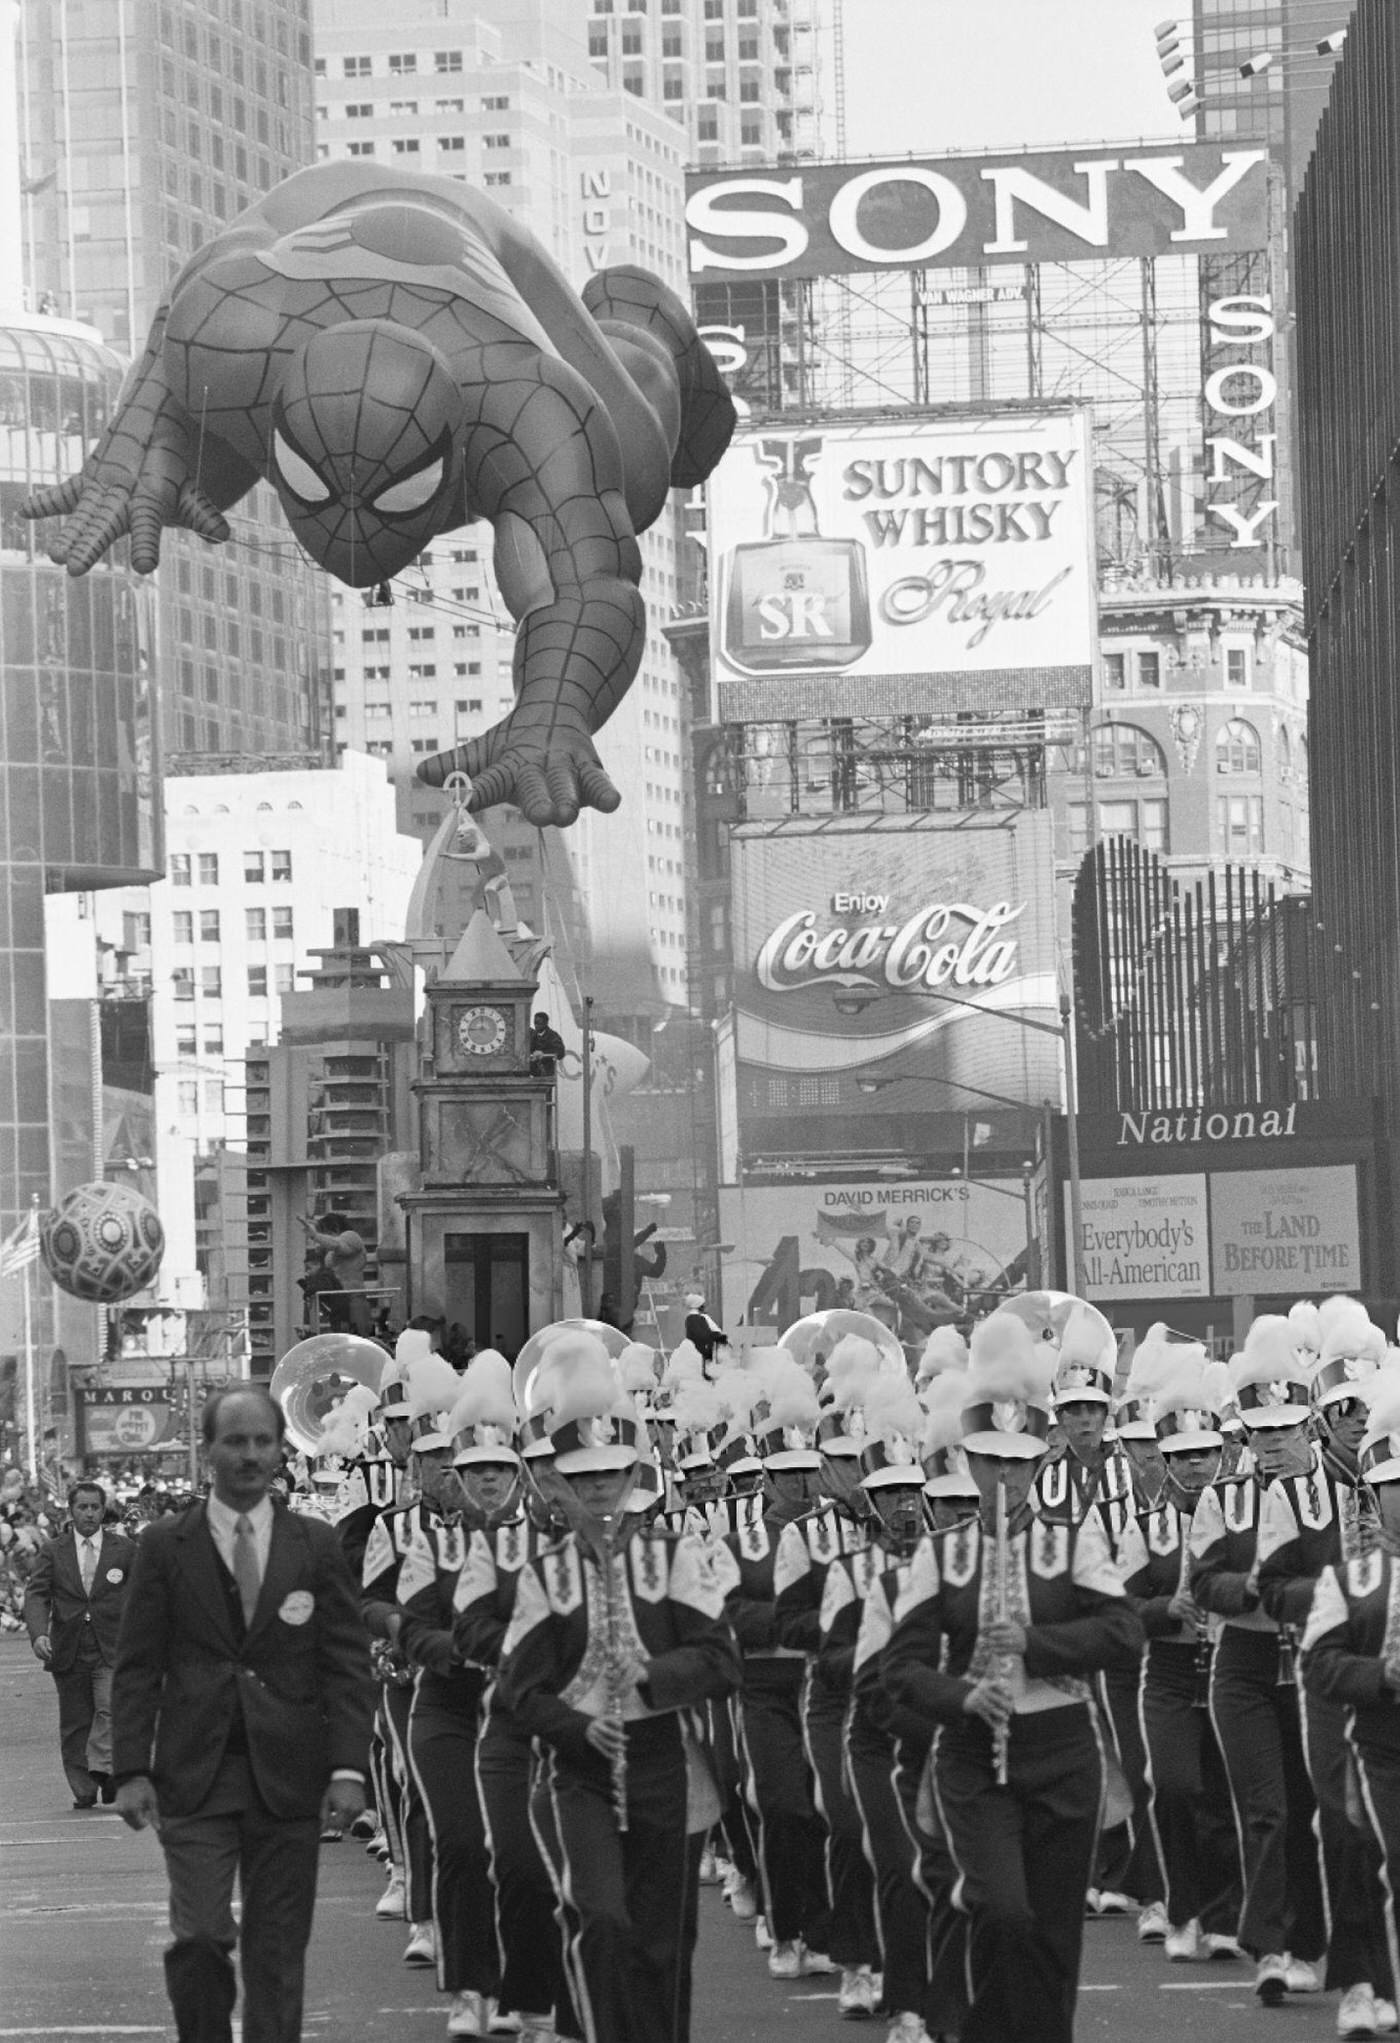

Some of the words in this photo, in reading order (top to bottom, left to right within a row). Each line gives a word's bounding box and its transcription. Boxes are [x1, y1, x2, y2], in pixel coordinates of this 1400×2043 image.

[685, 149, 1270, 273] SONY
[919, 291, 943, 305] VAN
[945, 287, 995, 303] WAGNER
[1205, 294, 1280, 548] SONY
[842, 449, 1078, 501] SUNTORY
[861, 500, 1063, 549] WHISKY
[758, 592, 834, 640] SR
[876, 558, 1075, 651] Royal
[834, 892, 889, 913] Enjoy
[757, 900, 1028, 992] Coca-Cola
[1116, 1102, 1297, 1145] National
[824, 1191, 874, 1207] DAVID
[877, 1186, 970, 1204] MERRICK'S
[1082, 1218, 1194, 1257] Everybody's
[1241, 1221, 1263, 1234] THE
[1263, 1210, 1320, 1239] LAND
[1224, 1243, 1299, 1272] BEFORE
[1300, 1243, 1350, 1274] TIME
